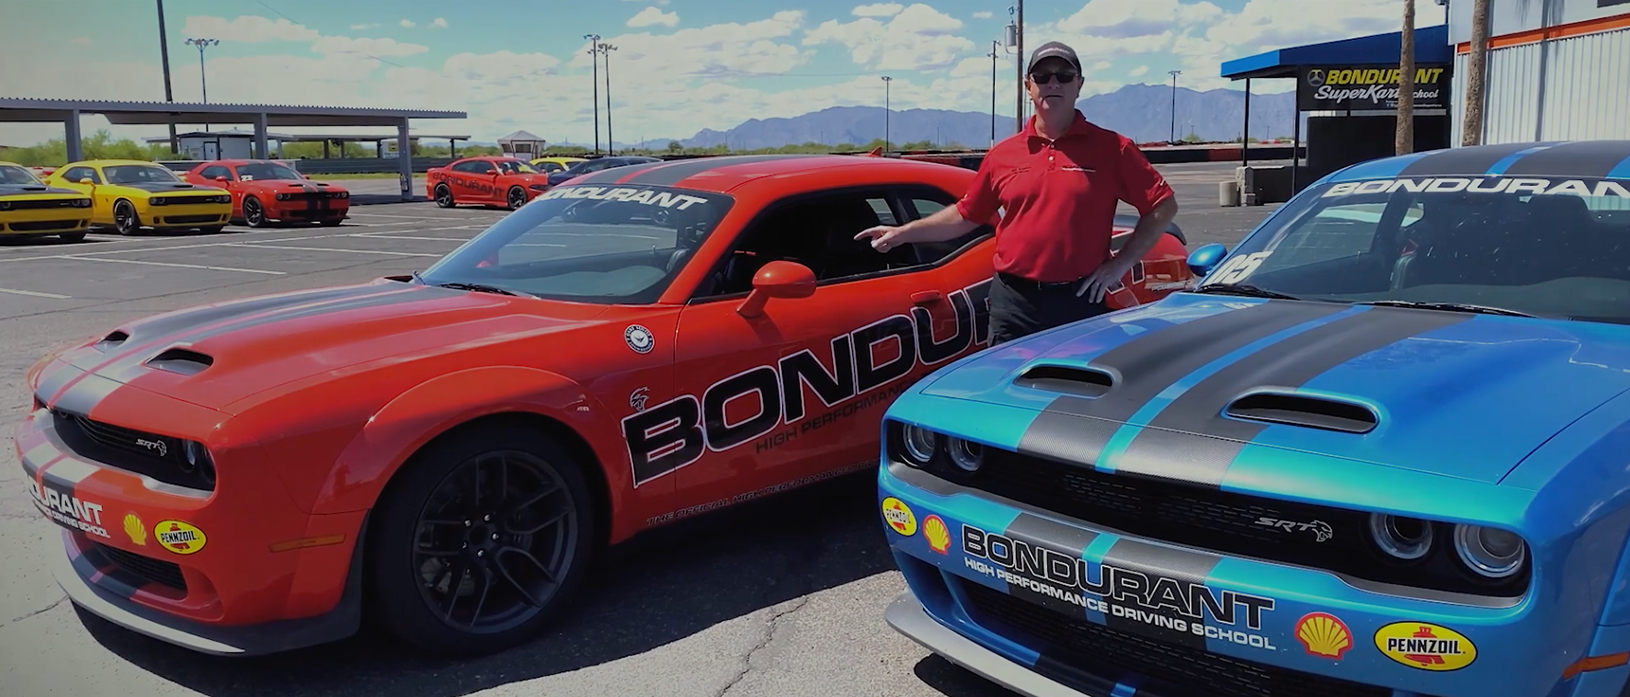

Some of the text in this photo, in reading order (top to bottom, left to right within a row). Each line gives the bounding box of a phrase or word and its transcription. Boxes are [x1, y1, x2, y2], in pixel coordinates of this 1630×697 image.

[1325, 68, 1443, 85] BONDURNT
[1413, 89, 1439, 99] chool
[432, 172, 505, 197] BONDURANT
[755, 379, 911, 453] HIGH PERFORMAN
[136, 439, 160, 450] SRT
[647, 511, 674, 525] THE
[676, 497, 731, 518] OFFICIAL
[1254, 517, 1317, 533] SRT
[161, 530, 197, 543] PENNZOIL
[962, 523, 1274, 631] BONDURANT
[964, 557, 1276, 651] HIGH PERFORMANCE DRIVING SCHOOL
[1387, 637, 1462, 655] PENNZOIL
